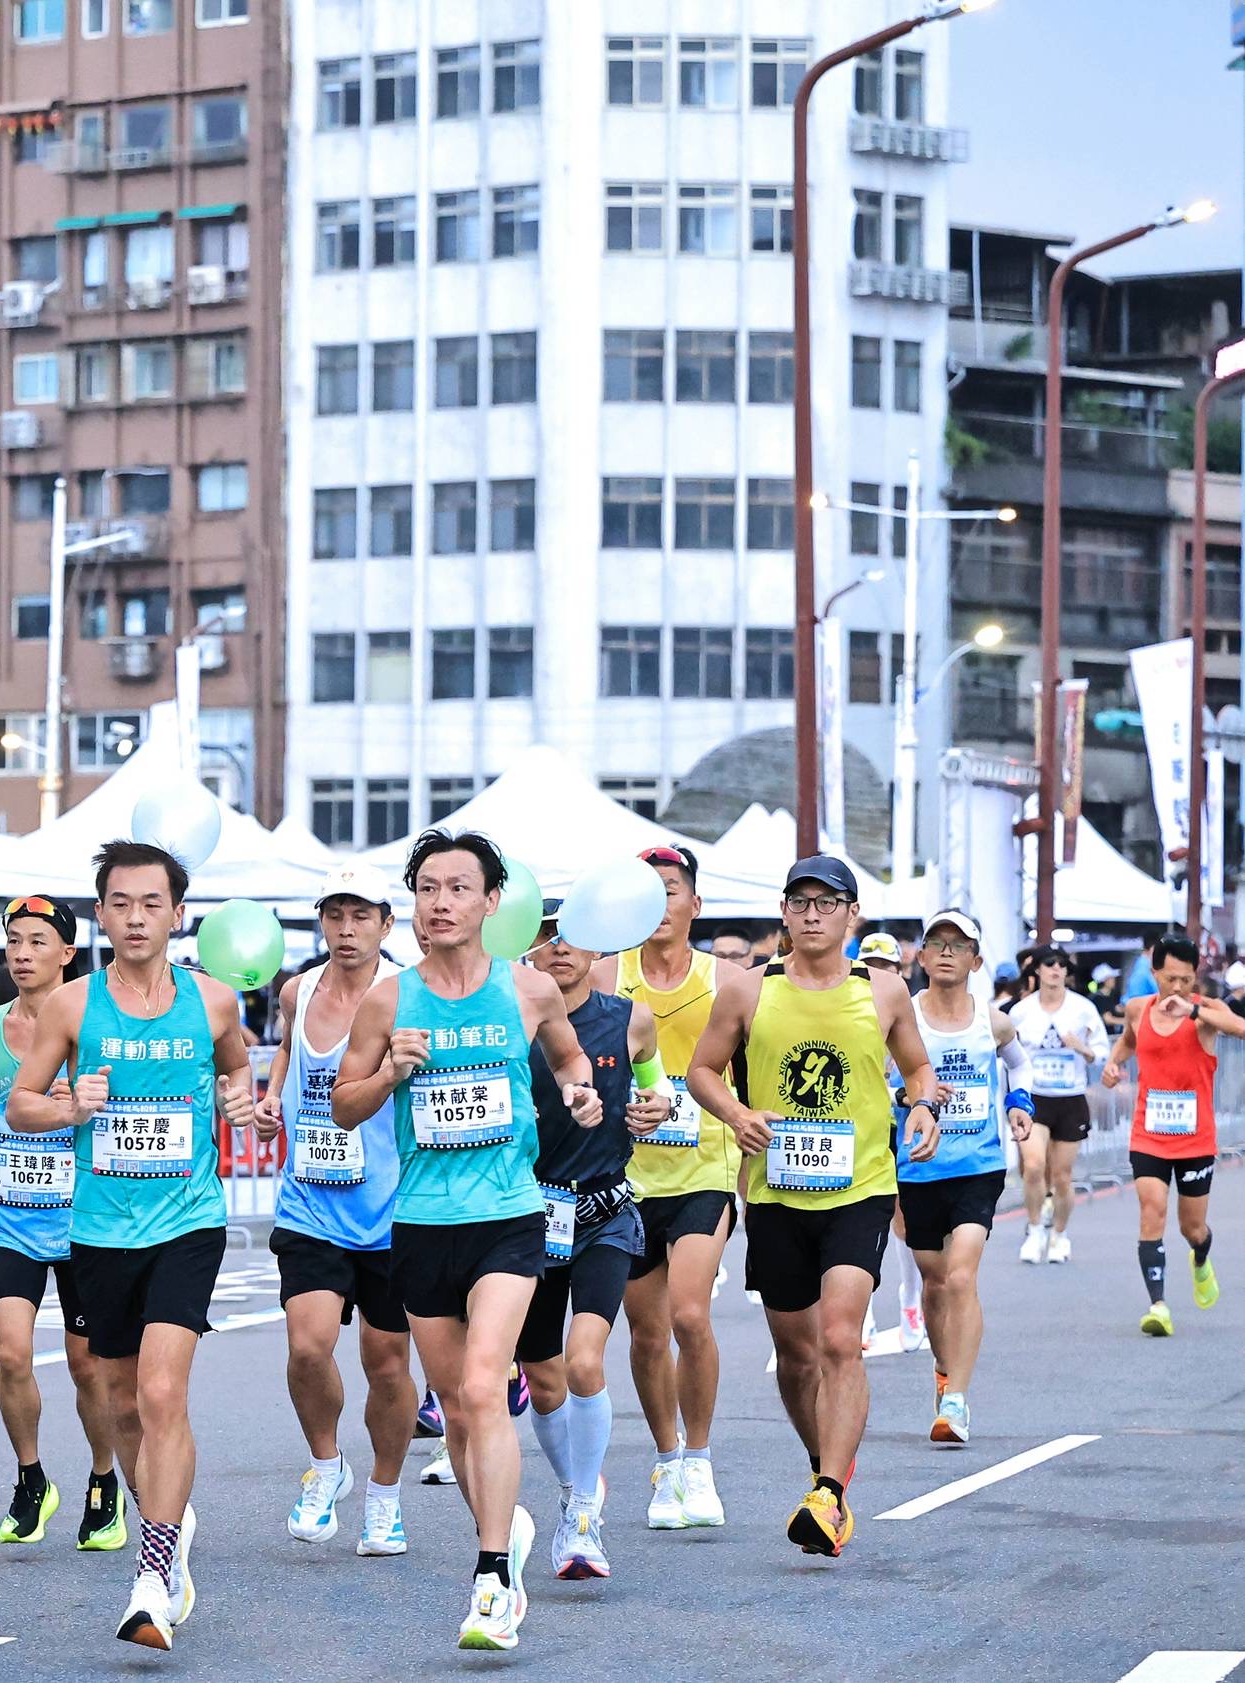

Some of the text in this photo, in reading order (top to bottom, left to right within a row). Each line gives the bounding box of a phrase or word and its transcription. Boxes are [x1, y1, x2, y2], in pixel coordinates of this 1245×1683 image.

[100, 1037, 195, 1060] 運動筆記
[779, 1040, 851, 1076] XIZHI RUNNING CLUB
[413, 1093, 424, 1101] 21
[778, 1084, 850, 1117] 2017 TAIWAN XRC
[434, 1105, 486, 1122] 10579
[112, 1117, 170, 1134] 林宗慶
[115, 1136, 166, 1151] 10578
[307, 1129, 348, 1146] 張兆宏
[784, 1136, 833, 1152] 呂賢良
[9, 1153, 56, 1170] 王瑋隆
[309, 1147, 346, 1161] 10073
[785, 1153, 830, 1167] 11090
[11, 1170, 53, 1185] 10672
